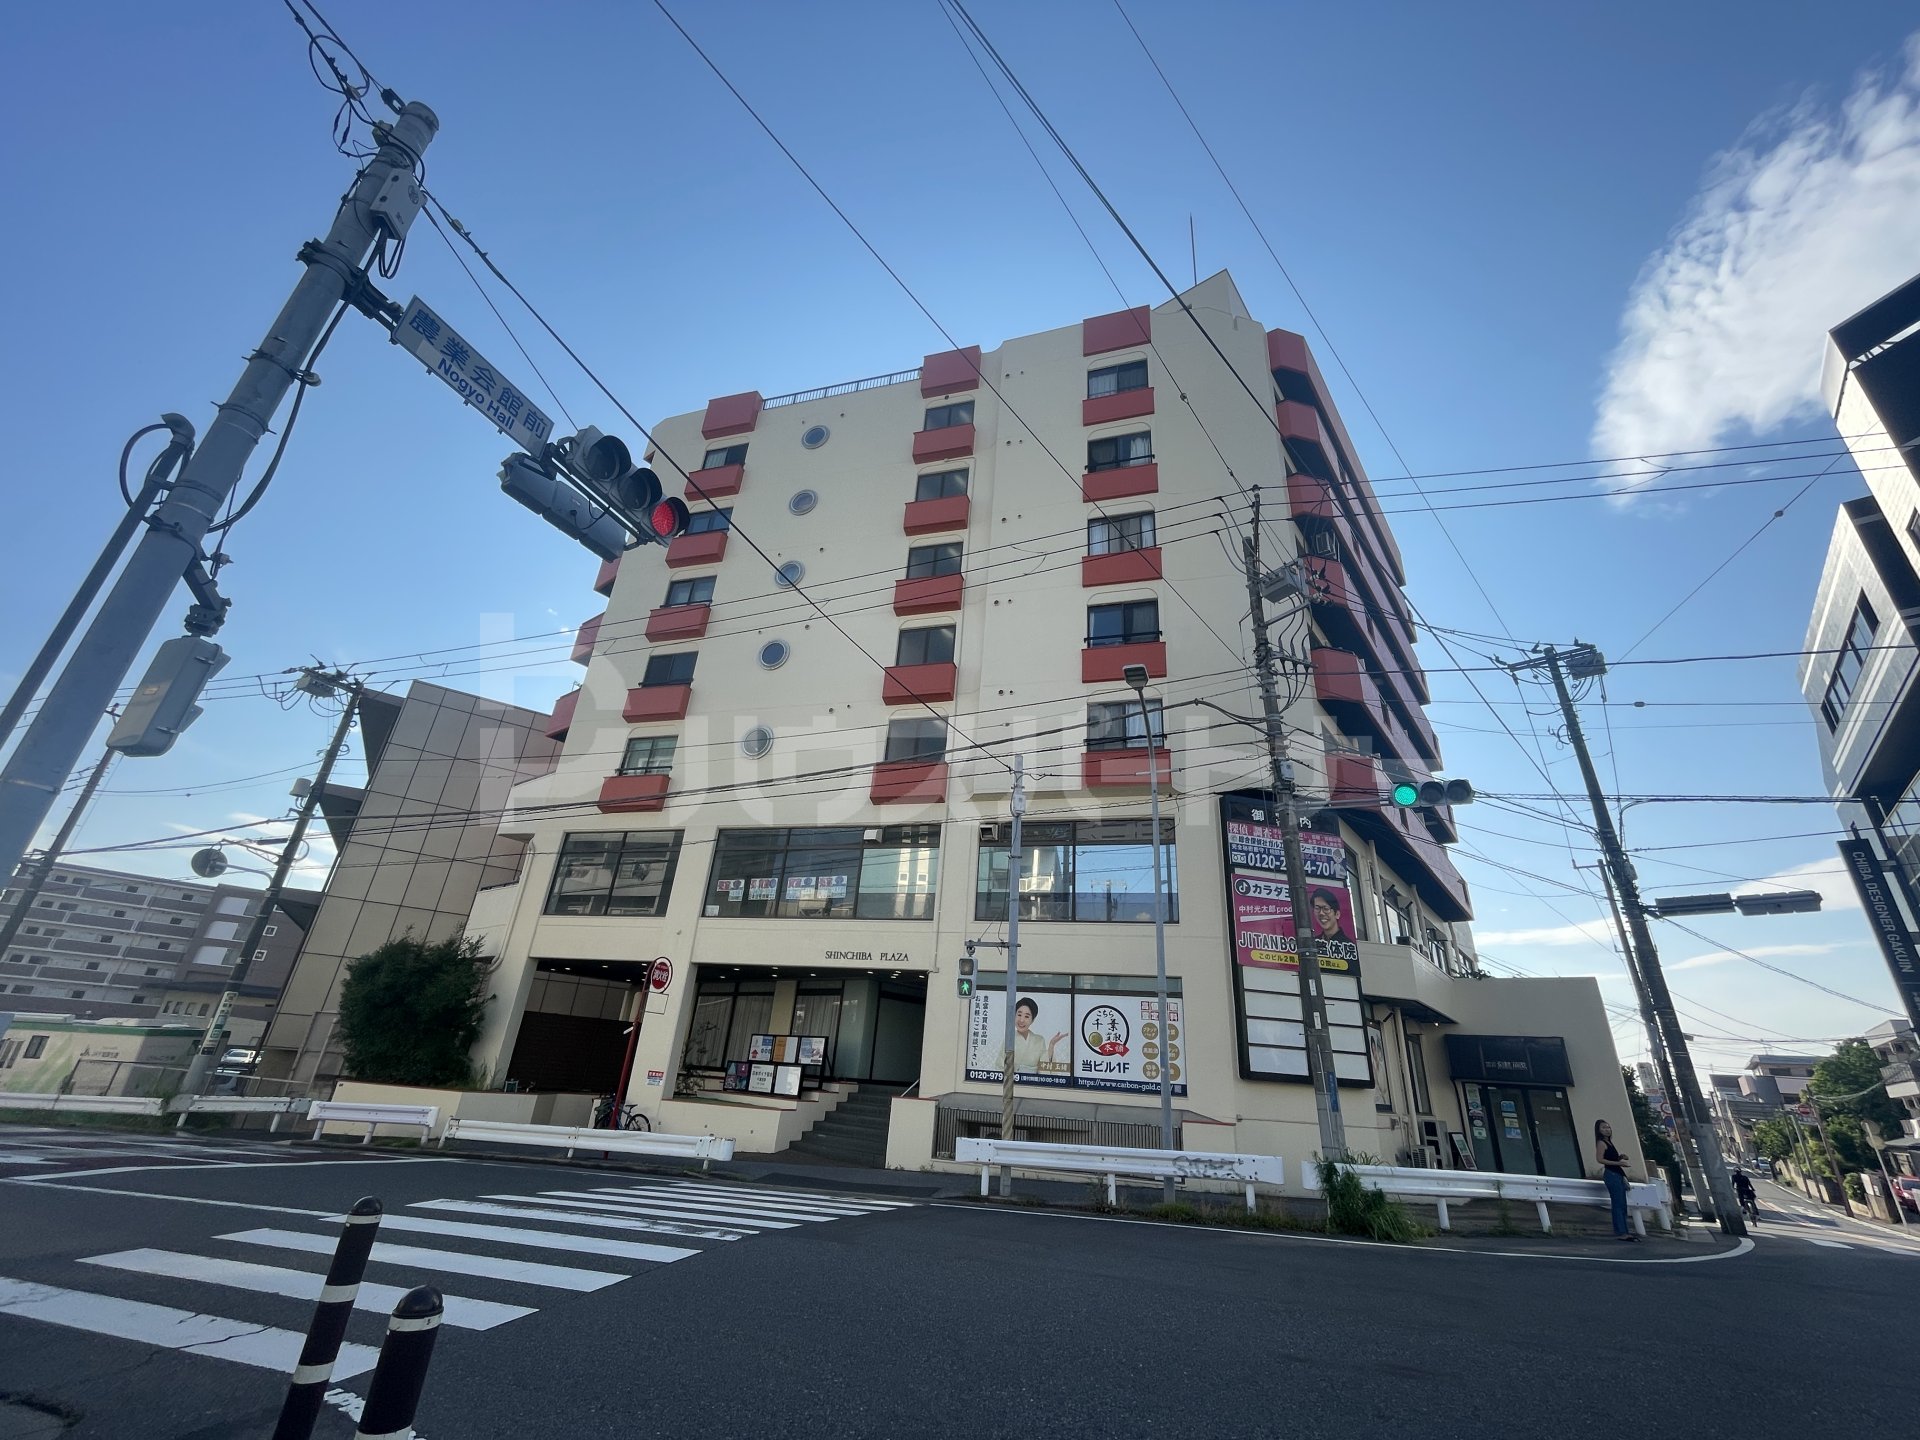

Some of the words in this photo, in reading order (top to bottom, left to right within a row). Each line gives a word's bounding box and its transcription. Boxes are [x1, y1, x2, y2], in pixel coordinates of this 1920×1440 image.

[408, 308, 547, 440] 農業会館前
[437, 357, 485, 405] Nogyo
[486, 399, 515, 430] Hall
[1251, 808, 1311, 829] 御内
[1238, 904, 1293, 914] 中村光太郎prod
[1852, 850, 1873, 882] CHIBA
[1866, 881, 1894, 932] DESIGNER
[1886, 930, 1915, 974] GAKUIN
[824, 950, 873, 961] SHINCHIBA
[880, 952, 909, 962] PLAZA
[980, 995, 989, 1046] 豊富な買取品目
[1096, 1009, 1115, 1018] こちら
[971, 995, 981, 1067] お気軽にご相談下さい
[1092, 1018, 1120, 1032] 千葉
[1081, 1059, 1130, 1074] 当ビル1F
